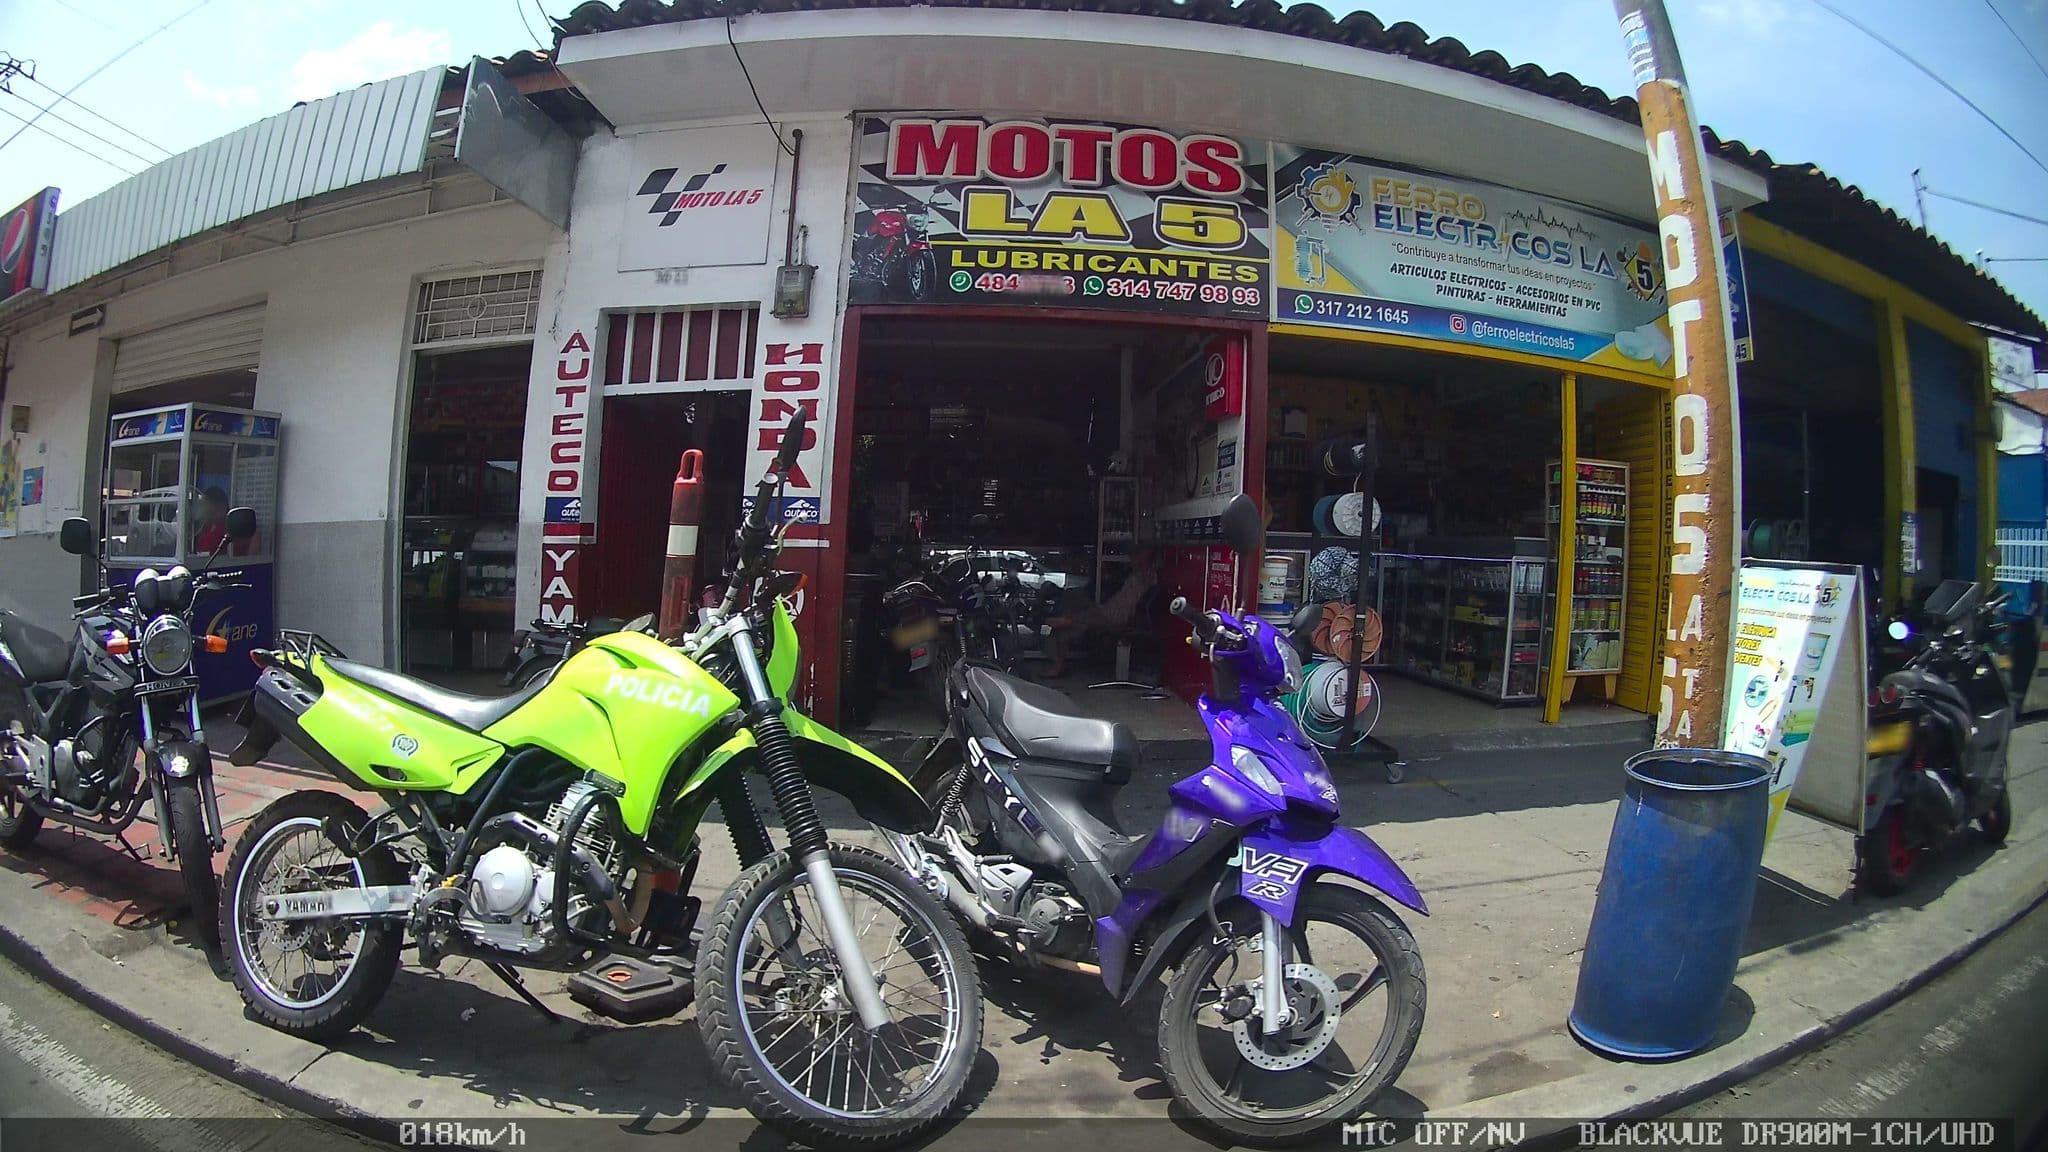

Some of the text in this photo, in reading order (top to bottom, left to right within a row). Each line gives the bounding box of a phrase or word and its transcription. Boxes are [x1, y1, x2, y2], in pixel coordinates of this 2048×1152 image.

[891, 122, 1244, 195] MOTOS
[673, 189, 764, 209] MOTO LA 5
[1370, 177, 1487, 219] FERRO
[964, 190, 1244, 247] LA 5
[951, 250, 1259, 283] LUBRICANTES
[1448, 253, 1455, 262] a
[1455, 253, 1506, 272] transformar
[1507, 264, 1520, 276] tus
[1521, 267, 1543, 280] ideas
[1544, 274, 1555, 282] en
[1579, 245, 1619, 280] LA
[1635, 258, 1654, 292] 5
[1108, 278, 1260, 306] 314 747 98 93
[1390, 263, 1447, 281] ARTICULOS
[1449, 272, 1507, 291] ELECTRICOS
[1516, 285, 1569, 304] ACCESORIOS
[1571, 296, 1583, 307] EN
[1585, 299, 1601, 311] PVC
[1436, 285, 1485, 302] PINTURAS
[1496, 295, 1568, 317] HERRAMIENTAS
[1317, 300, 1409, 324] 317 212 1645
[1472, 320, 1575, 350] @ferroelectricosla5
[547, 332, 590, 492] AUTECO
[755, 343, 823, 489] HONDA
[784, 509, 818, 518] autco
[1821, 587, 1833, 603] 5
[146, 680, 188, 691] HONA
[604, 673, 712, 720] POLICIA
